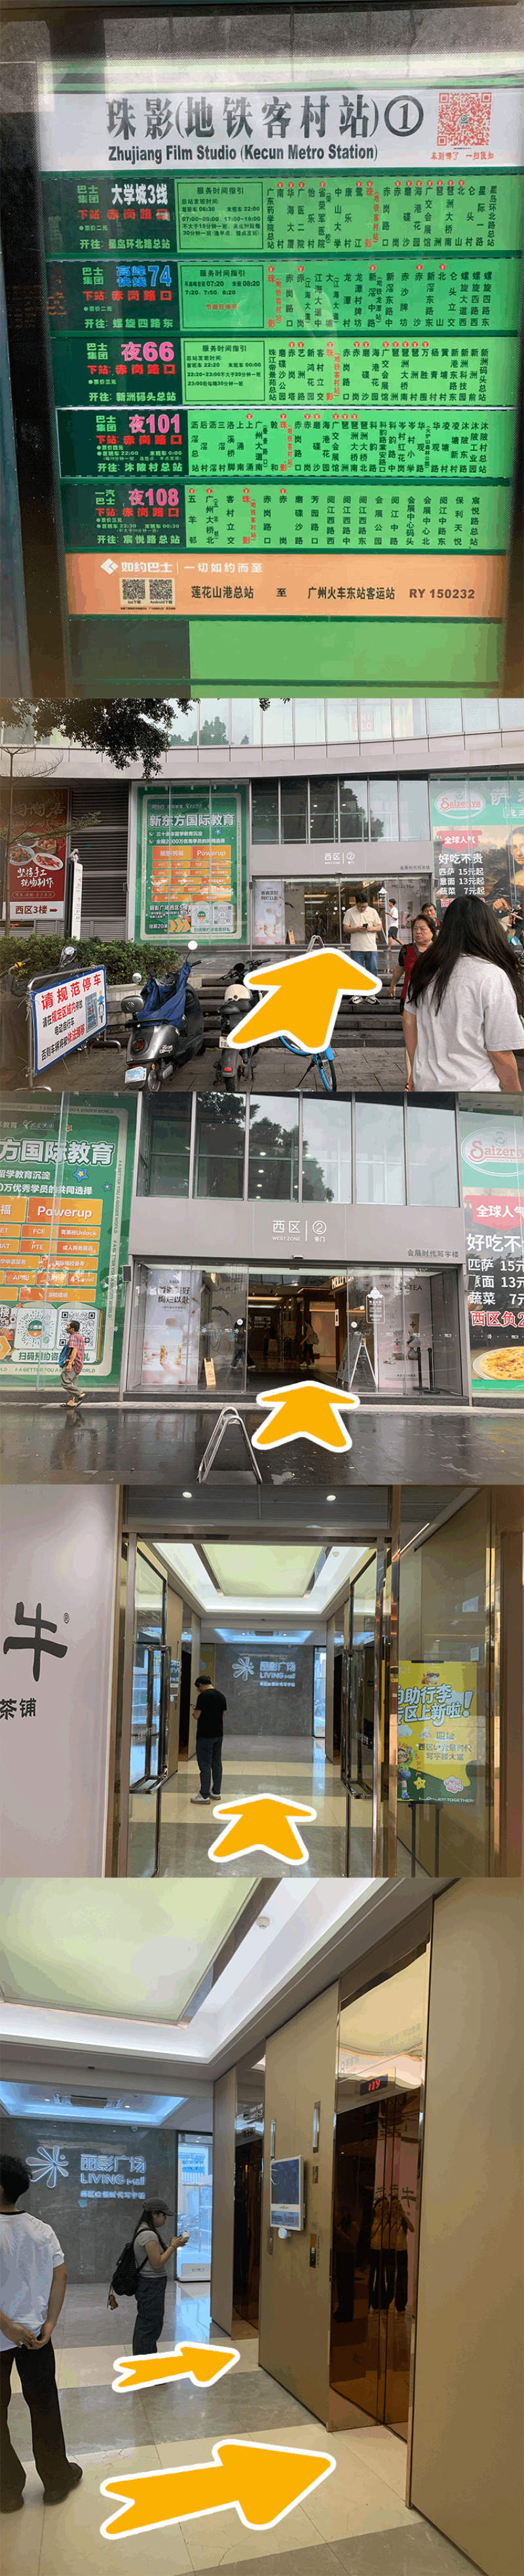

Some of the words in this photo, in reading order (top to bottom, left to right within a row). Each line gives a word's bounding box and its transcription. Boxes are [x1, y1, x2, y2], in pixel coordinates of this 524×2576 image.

[108, 146, 162, 164] Zhujiang
[166, 145, 193, 160] Film
[196, 145, 236, 160] Studio
[240, 144, 284, 162] (Kecun
[288, 144, 324, 160] Metro
[328, 143, 378, 162] Station)
[77, 185, 98, 194] 巴士
[111, 183, 168, 206] 大学城3线
[77, 194, 100, 204] 集团
[82, 266, 103, 276] 巴士
[148, 265, 172, 287] 74
[83, 276, 104, 285] 集团
[121, 342, 174, 361] 夜66
[116, 391, 176, 402] 新洲码头总站
[129, 414, 180, 433] 夜101
[128, 488, 179, 506] 夜108
[121, 561, 173, 573] 如约巴士
[184, 562, 263, 573] 一切如约而至
[191, 585, 254, 599] 莲花山港总站
[276, 588, 287, 597] 至
[307, 587, 395, 600] 广州火车东站客运站
[409, 589, 426, 598] RY
[430, 589, 475, 599] 150232
[149, 814, 235, 827] 新东方国际教育
[438, 854, 483, 865] 好吃不贵
[17, 867, 47, 879] 坚持手工
[440, 877, 455, 886] 意面
[458, 877, 485, 886] 13元起
[16, 905, 47, 915] 西区3楼
[41, 973, 102, 1011] 请规范停车
[37, 1206, 92, 1219] Powerup
[272, 1220, 301, 1233] 西区
[467, 1233, 524, 1252] 好吃不
[407, 1249, 459, 1258] 会展时代写字楼
[468, 1258, 494, 1271] 匹萨
[469, 1291, 496, 1305] 蔬菜
[3, 1601, 68, 1682] 牛
[0, 1697, 37, 1720] 茶铺
[436, 1731, 455, 1740] 地址
[81, 2154, 147, 2173] 丽影广场
[81, 2173, 125, 2185] LIVING
